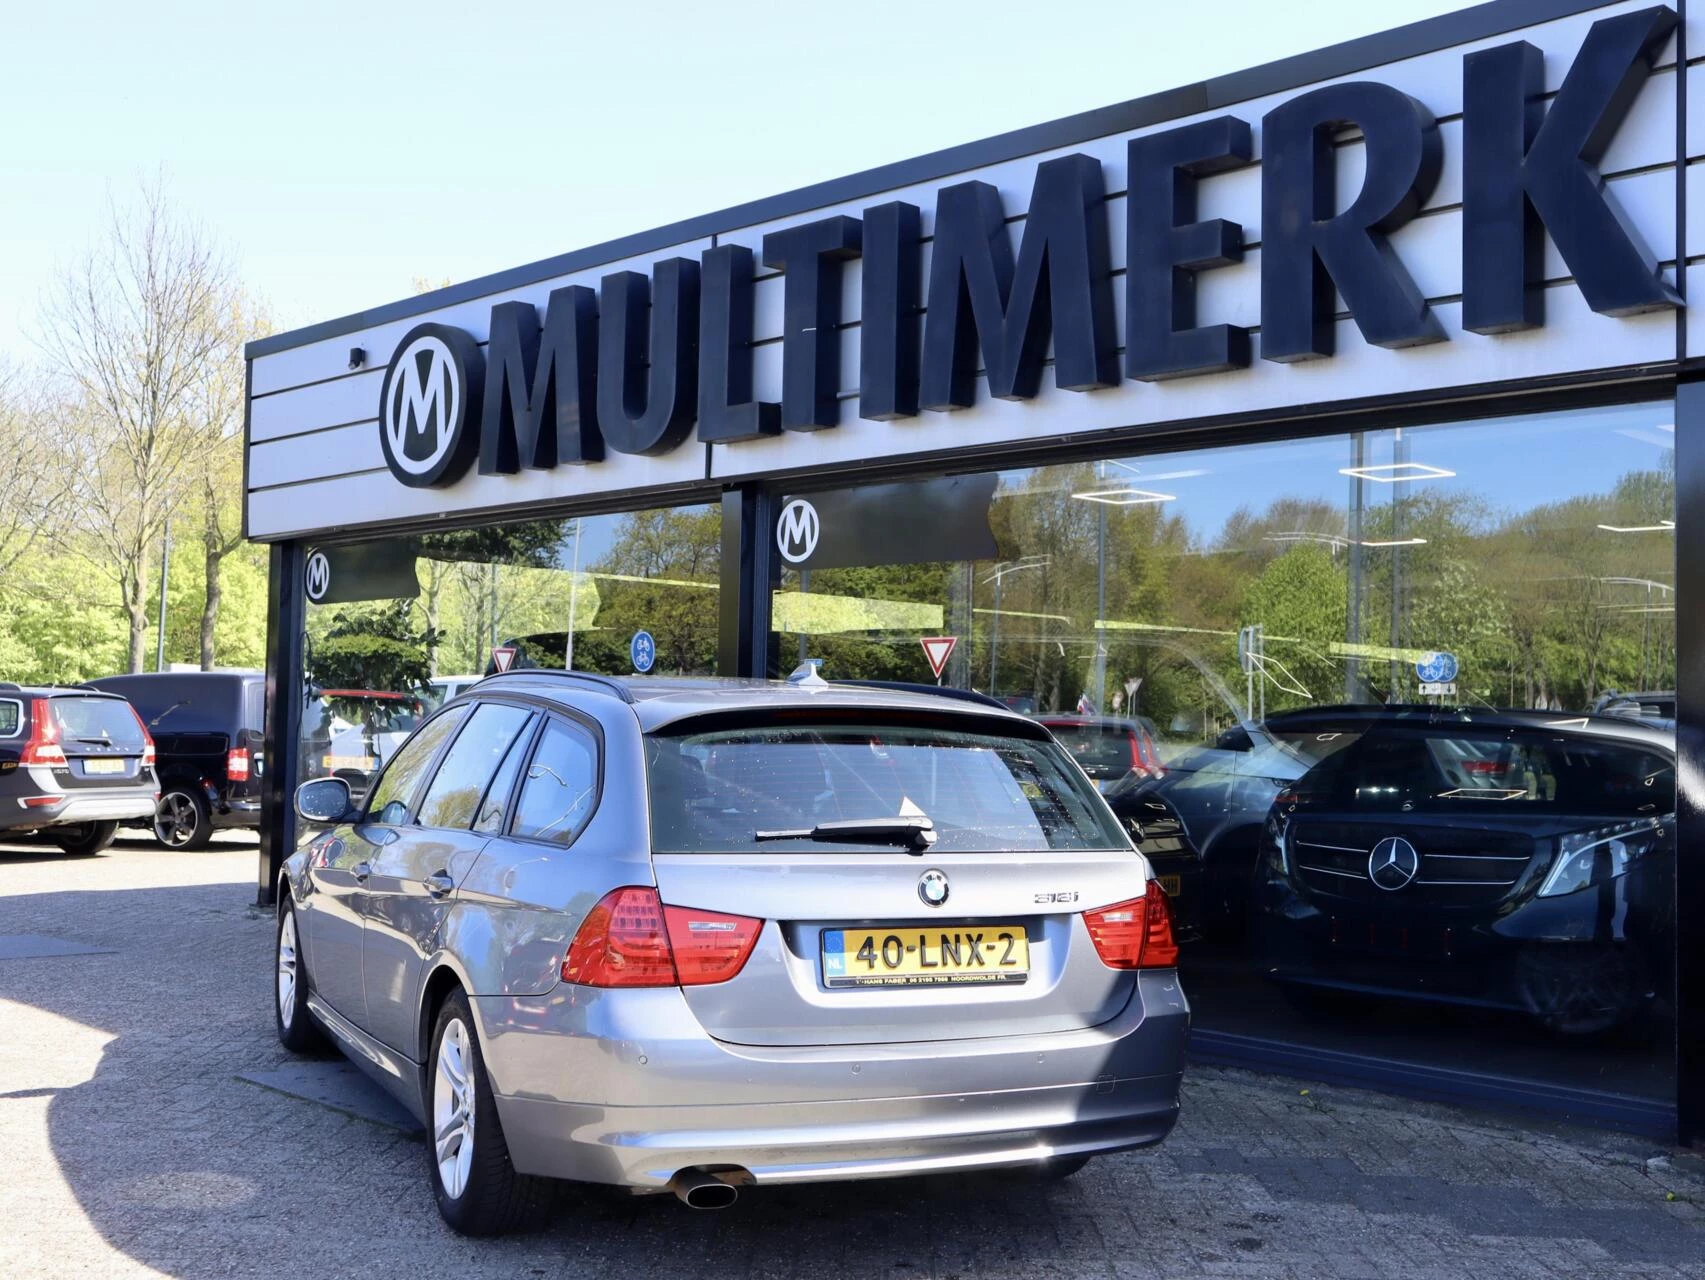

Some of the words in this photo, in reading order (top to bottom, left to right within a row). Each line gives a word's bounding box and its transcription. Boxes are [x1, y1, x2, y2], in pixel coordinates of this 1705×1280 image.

[478, 5, 1684, 476] MULTIMERK
[827, 959, 843, 969] NL
[855, 932, 1017, 969] 40-LNX-2
